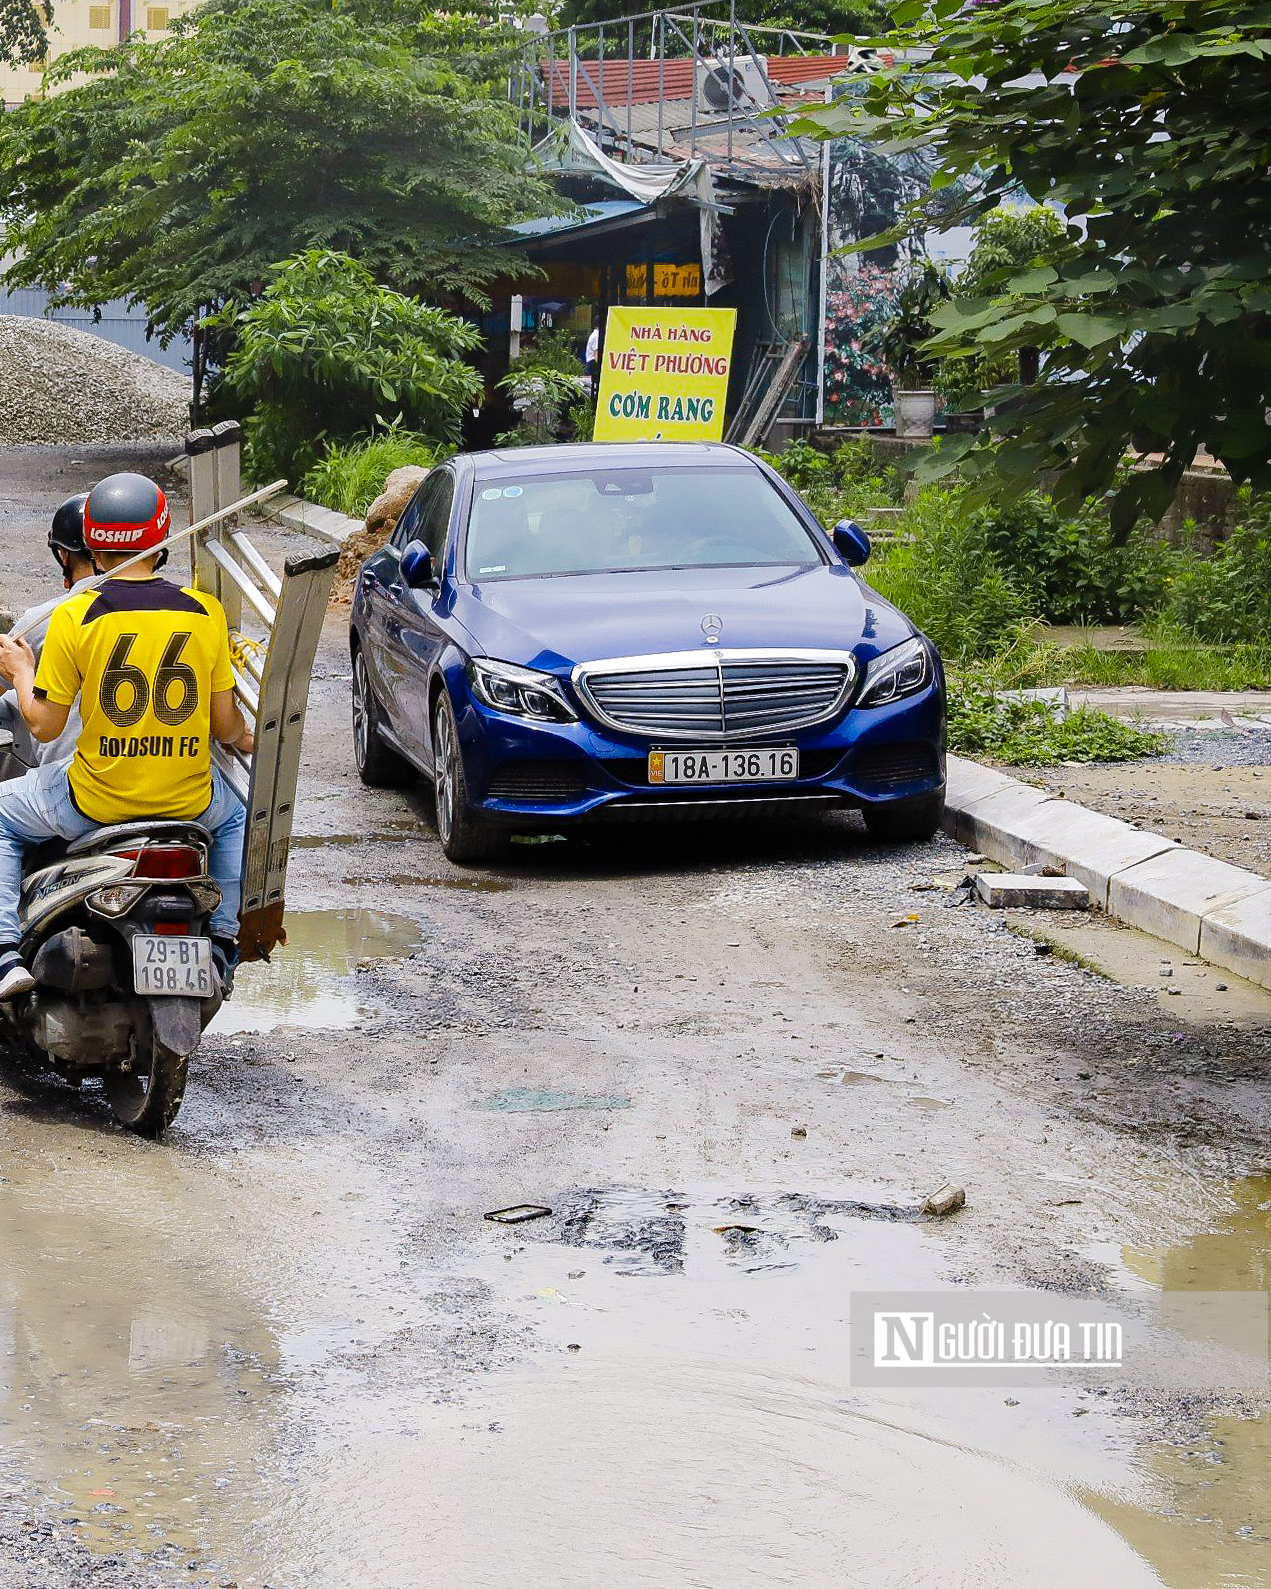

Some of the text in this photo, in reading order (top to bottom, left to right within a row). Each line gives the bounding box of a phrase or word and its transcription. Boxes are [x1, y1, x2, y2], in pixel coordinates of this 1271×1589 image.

[631, 323, 712, 342] NHÀ HÀNG
[609, 347, 727, 376] VIỆT PHƯƠNG
[609, 390, 714, 422] CƠM RANG
[90, 527, 150, 543] LOSHIP
[99, 632, 199, 727] 66
[99, 736, 200, 758] GOLDSUN FC
[671, 752, 794, 780] 18A-136.16
[145, 939, 199, 965] 29-B1
[141, 966, 208, 991] 198.46
